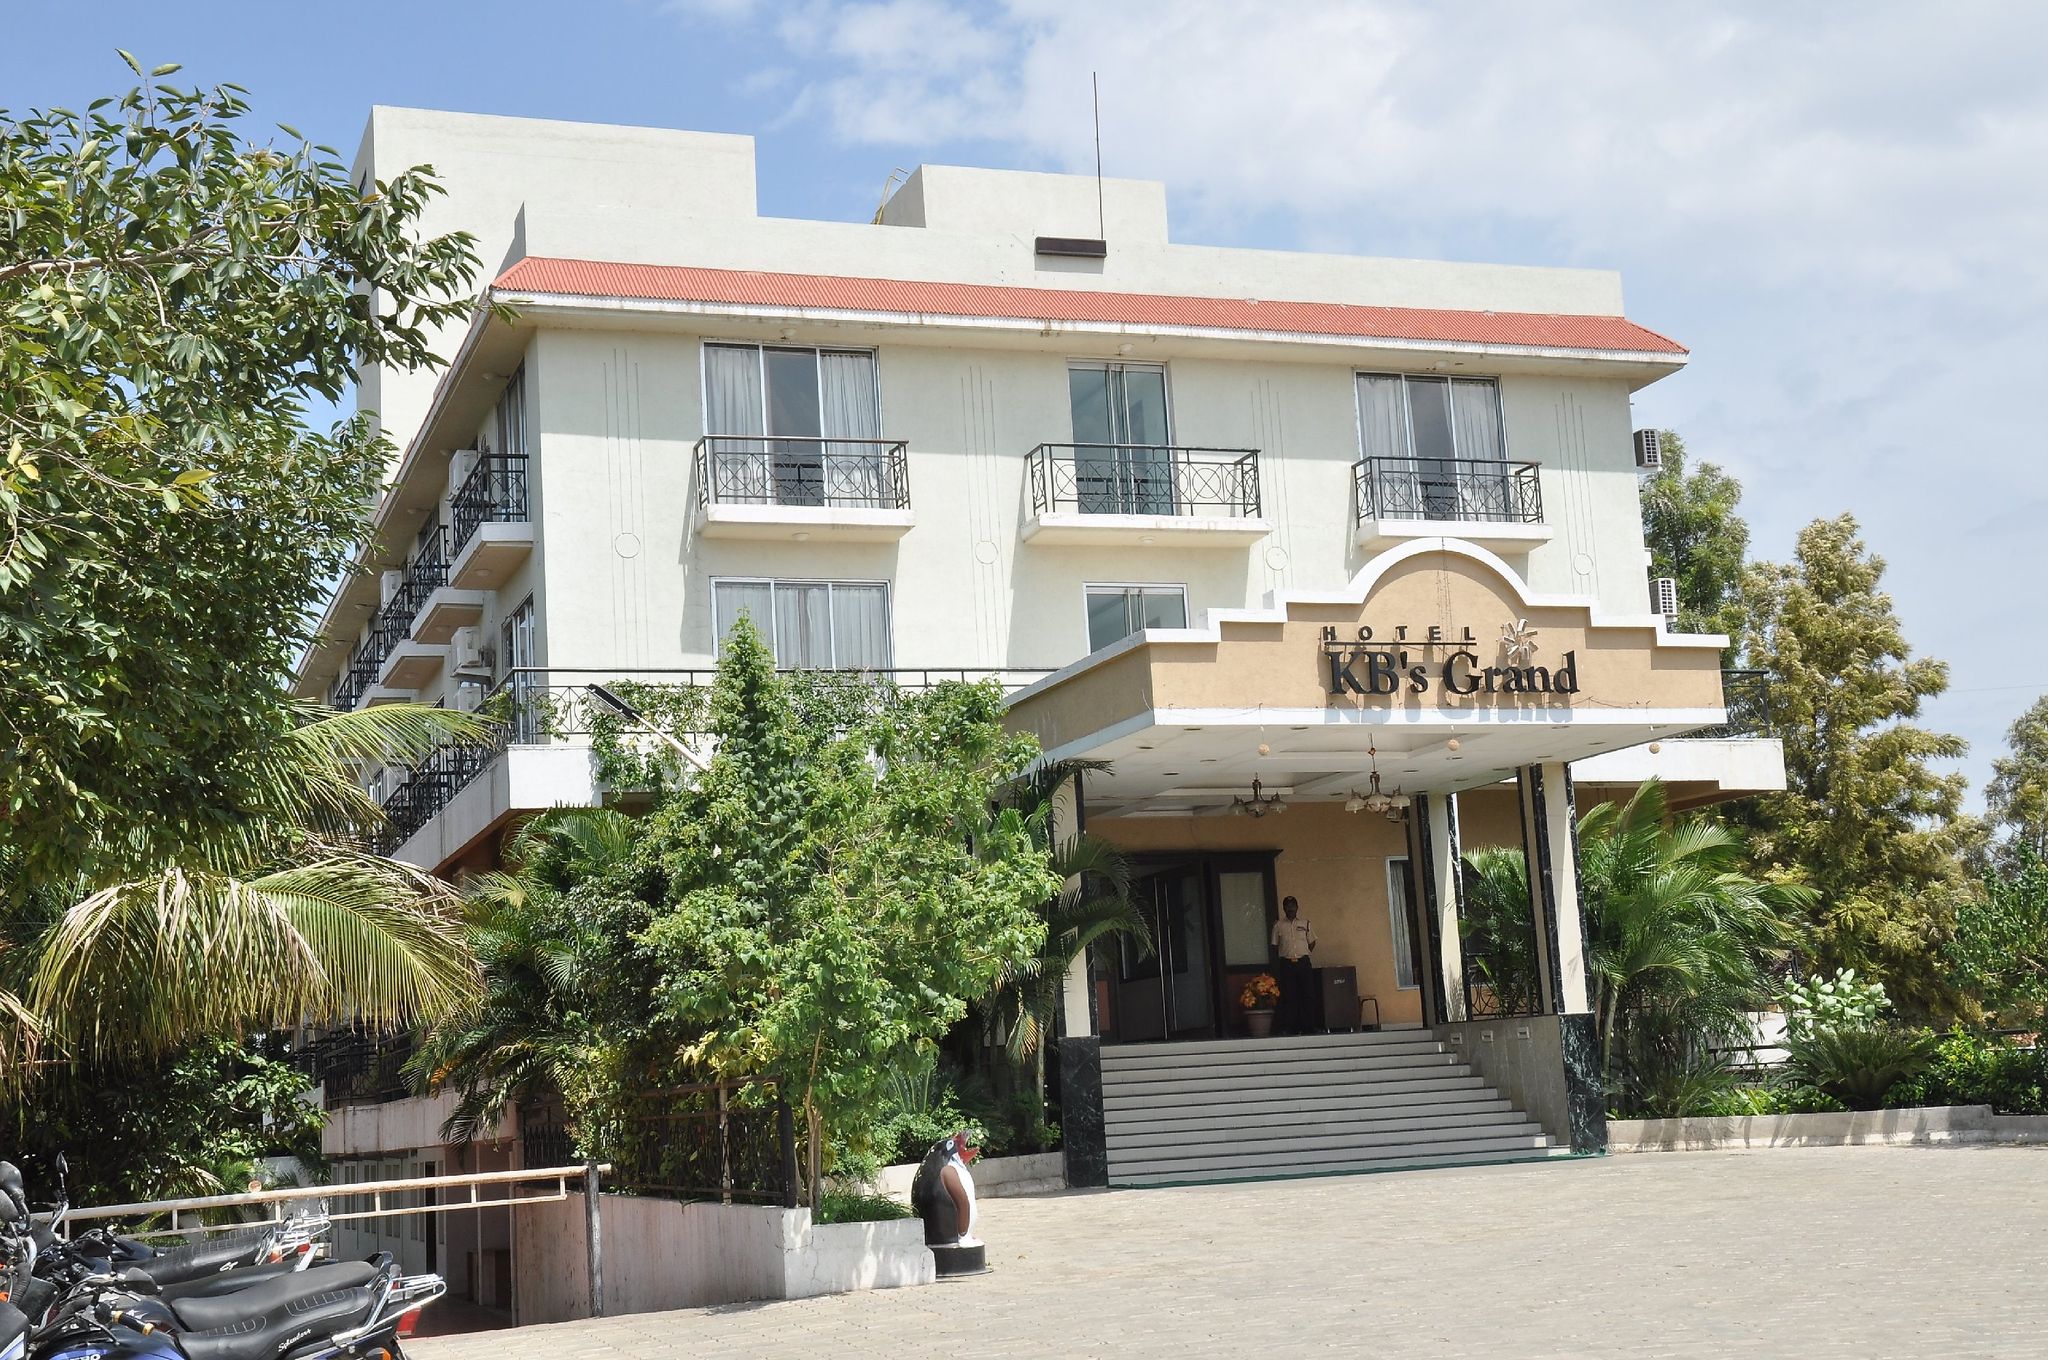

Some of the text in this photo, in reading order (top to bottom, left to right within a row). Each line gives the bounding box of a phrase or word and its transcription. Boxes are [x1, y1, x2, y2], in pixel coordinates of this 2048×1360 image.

[1322, 625, 1476, 641] HOTEL
[1325, 649, 1581, 695] KB's Grand
